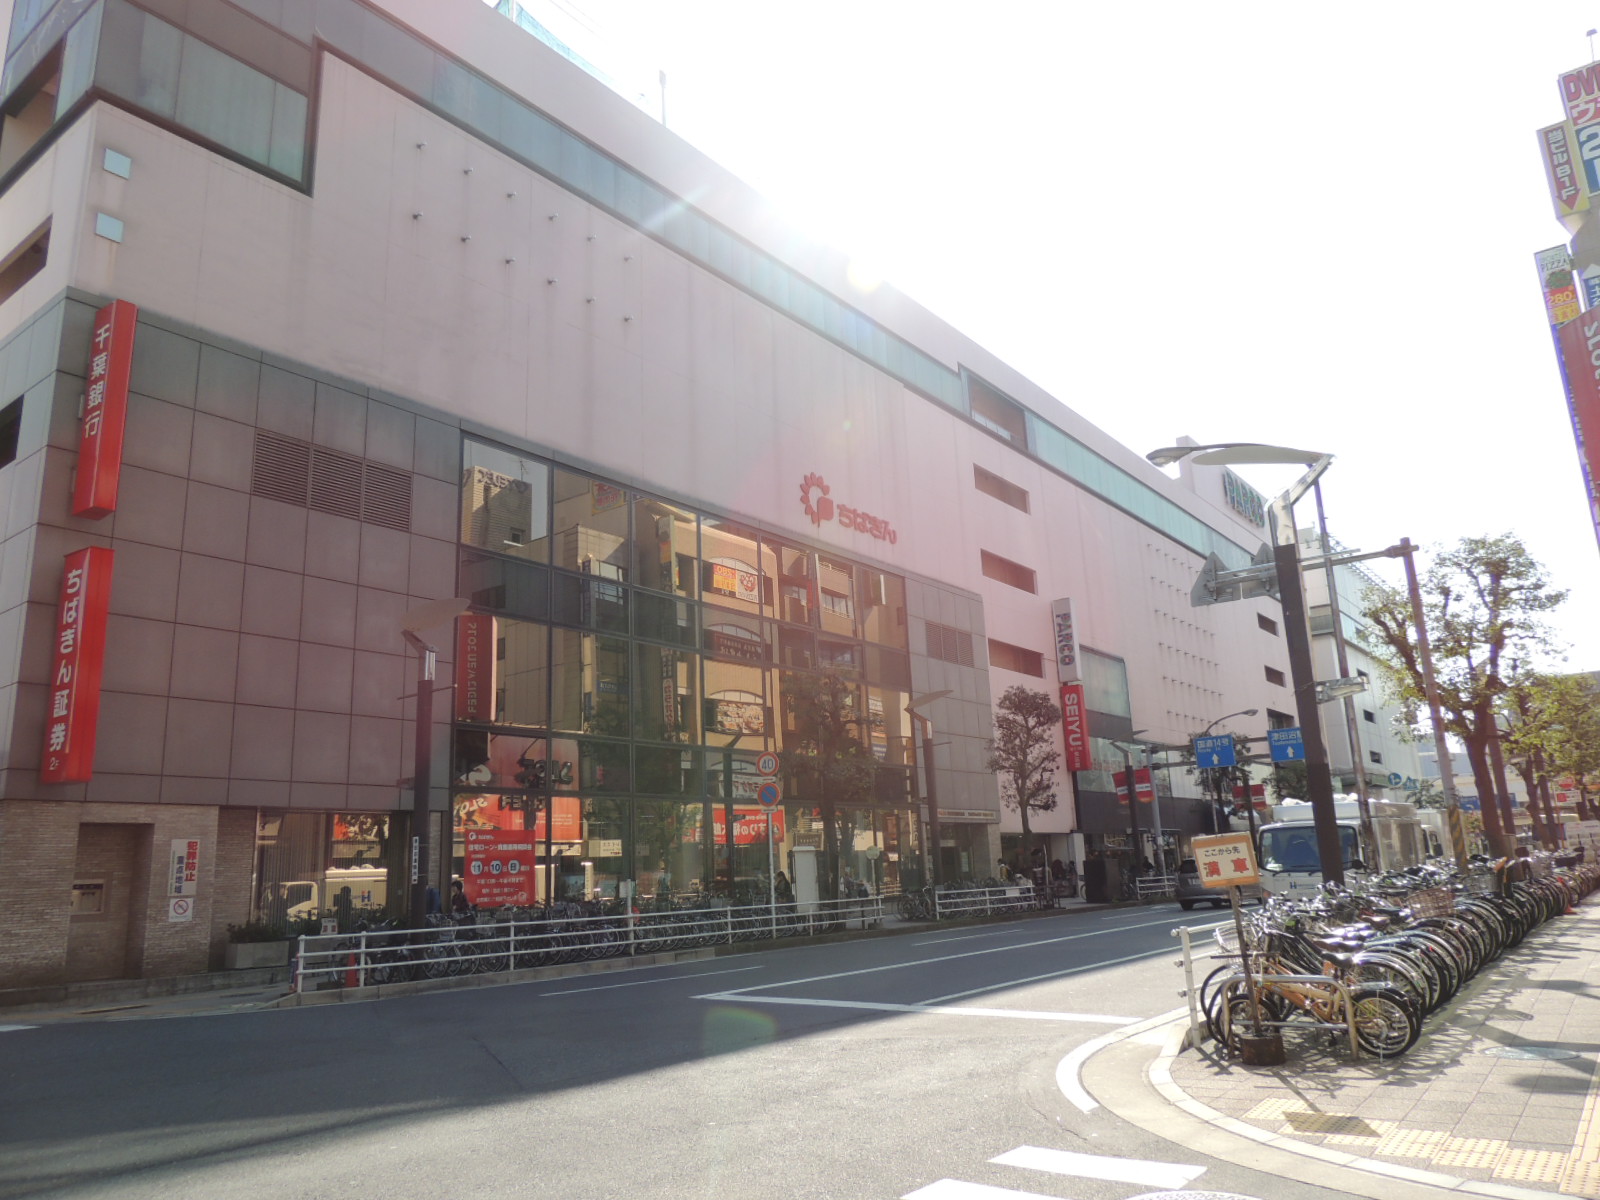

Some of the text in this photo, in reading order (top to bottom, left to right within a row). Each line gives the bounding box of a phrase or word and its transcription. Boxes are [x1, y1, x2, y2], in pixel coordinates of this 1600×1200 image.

[1541, 258, 1569, 273] PIZZA
[85, 323, 110, 438] 千葉銀行
[1221, 470, 1265, 528] PARCO
[836, 503, 897, 545] ちばぎん
[50, 568, 82, 752] ちばぎん証券
[1056, 612, 1076, 667] PARCO
[1065, 693, 1081, 747] SEIYU
[49, 757, 60, 770] 2F
[762, 759, 774, 770] 40
[184, 841, 198, 882] 犯罪防止
[1204, 846, 1241, 857] ここから先
